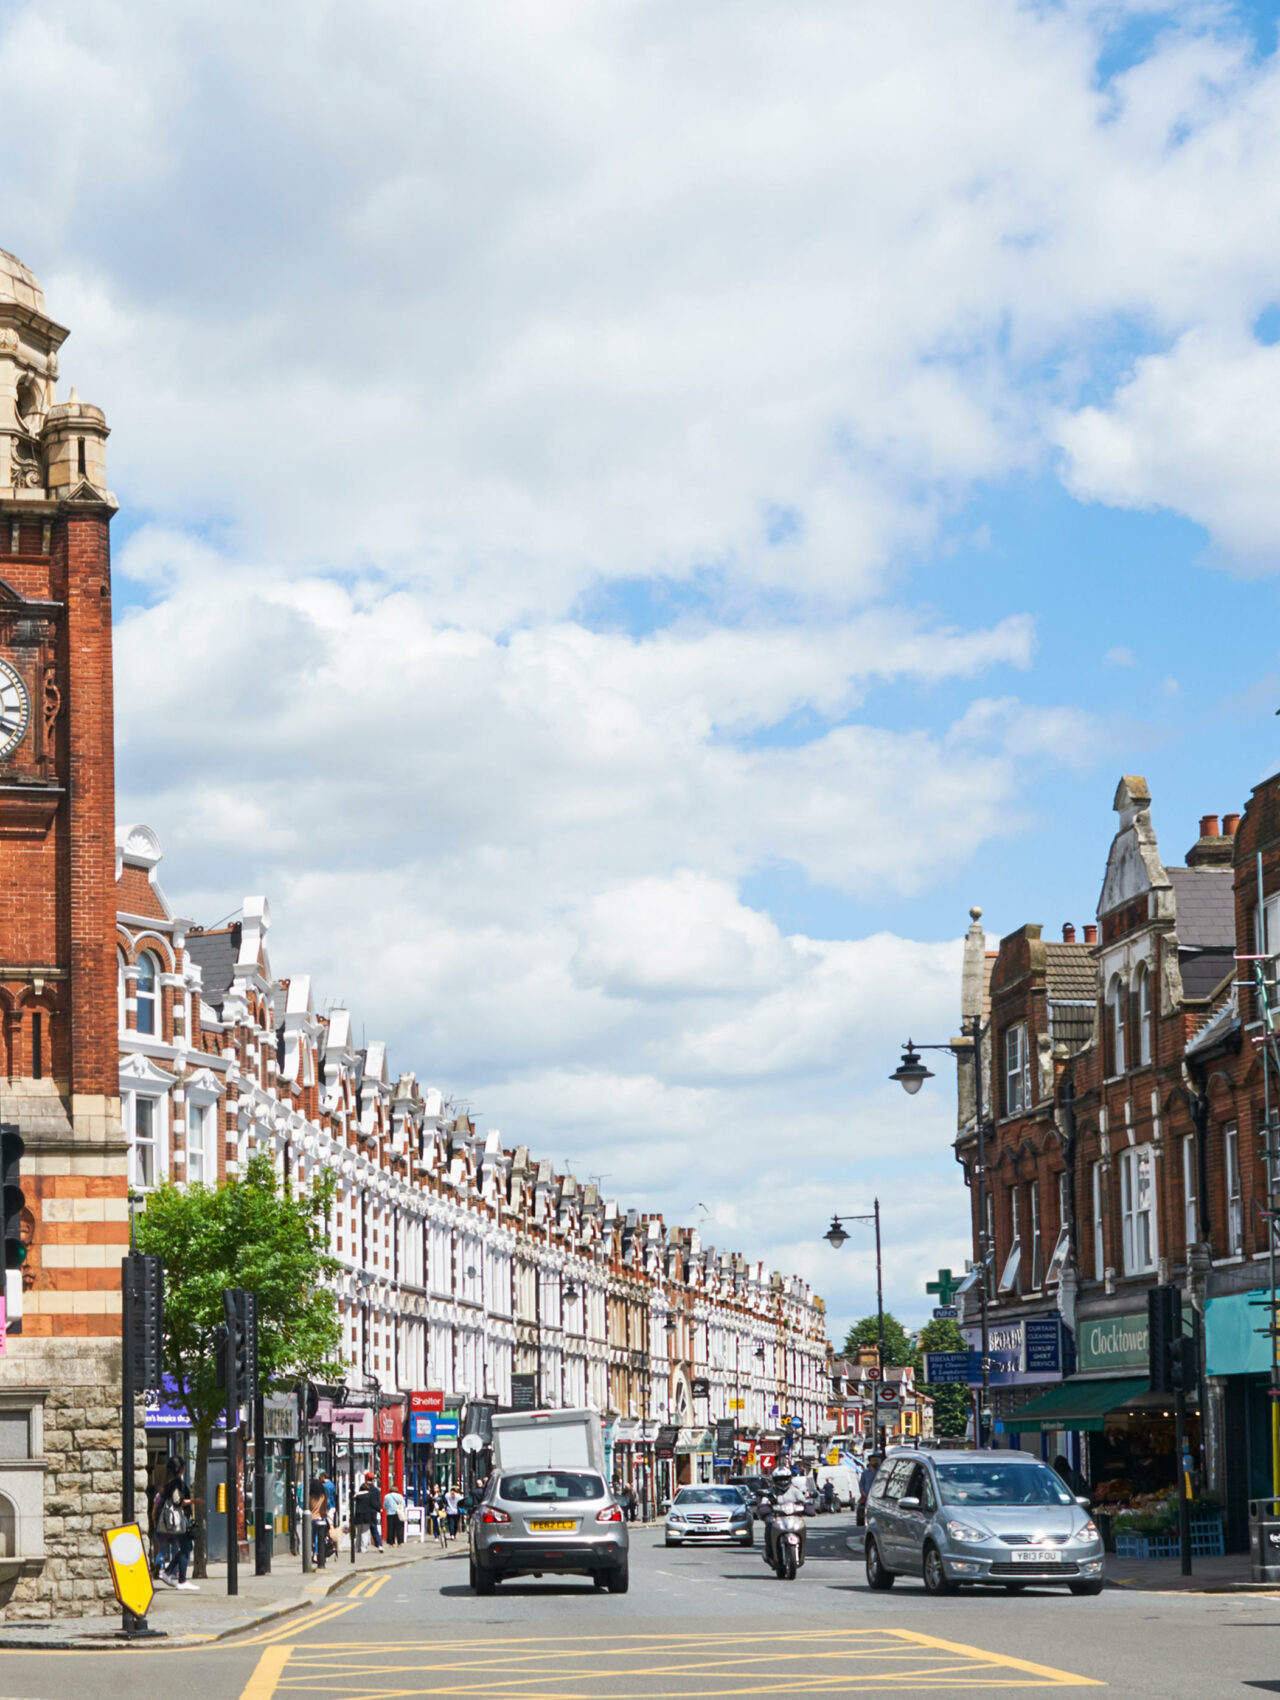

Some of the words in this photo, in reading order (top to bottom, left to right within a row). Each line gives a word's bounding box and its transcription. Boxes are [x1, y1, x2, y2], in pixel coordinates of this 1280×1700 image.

[1090, 1325, 1148, 1355] Clocktower
[412, 1397, 441, 1406] Shelter
[1017, 1552, 1037, 1561] YB13
[1038, 1552, 1057, 1561] FOU
